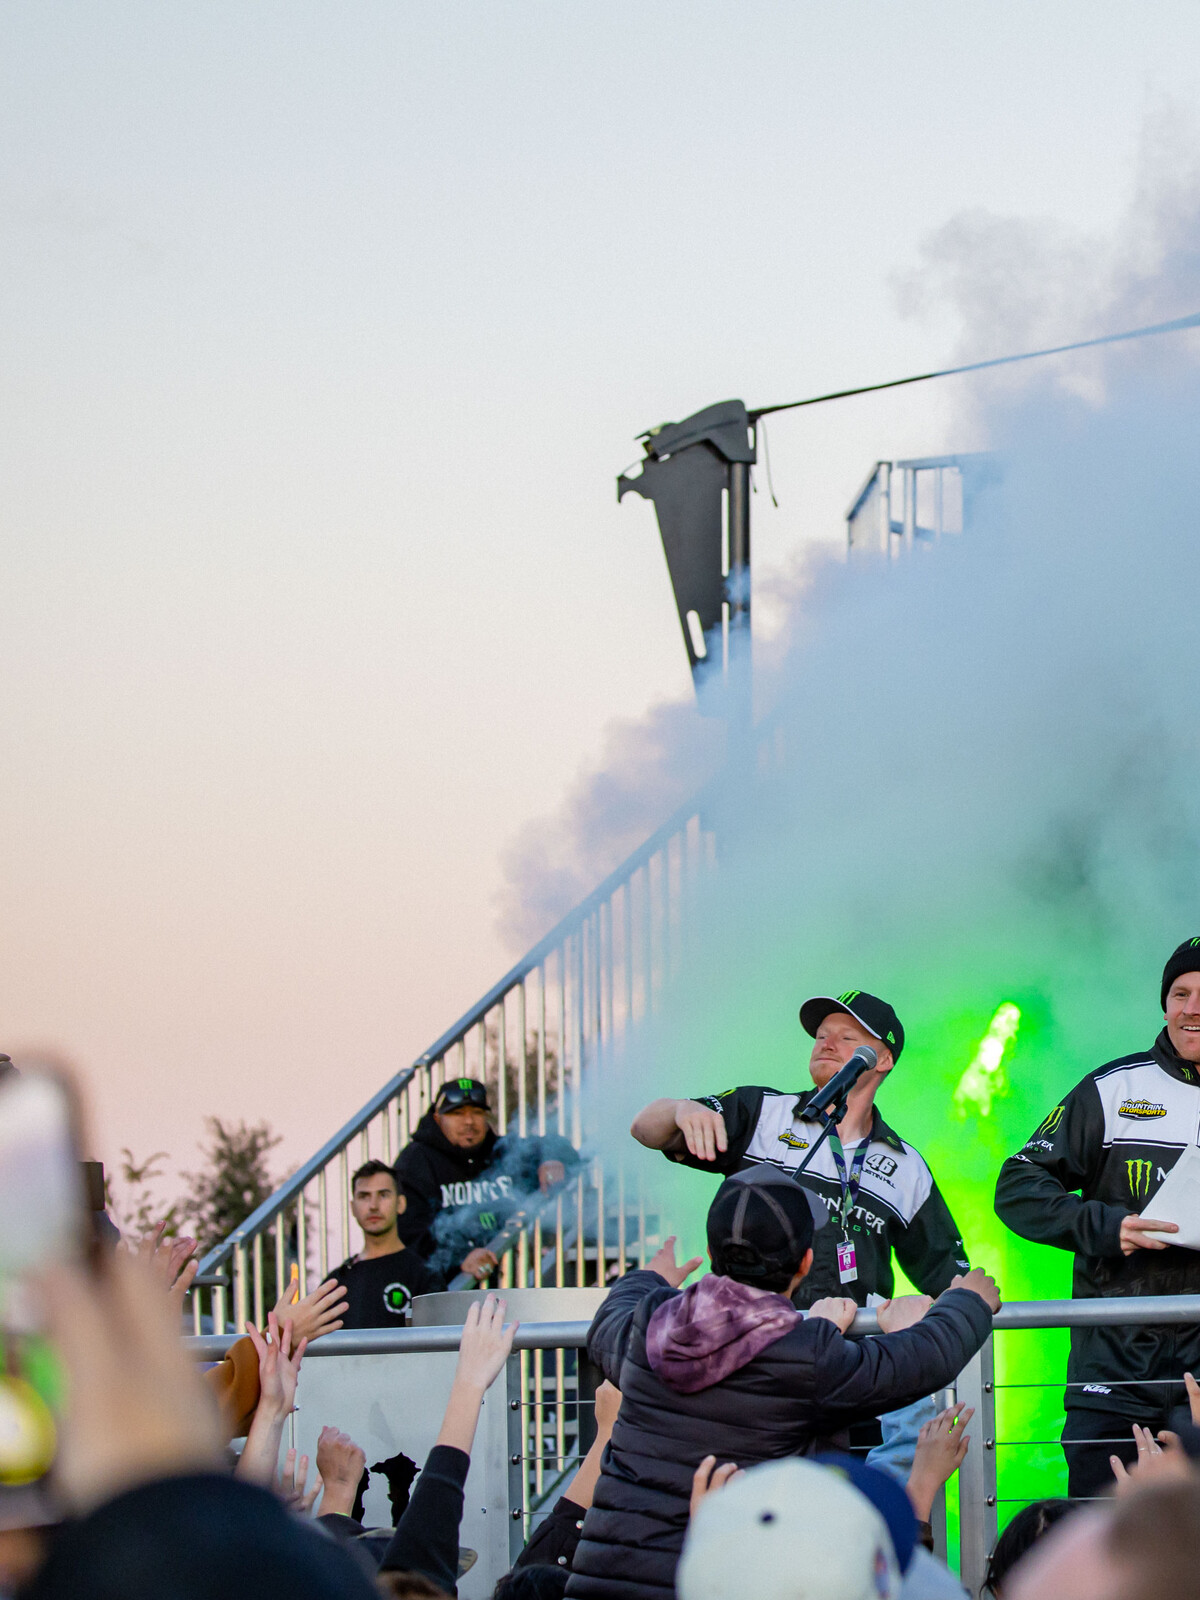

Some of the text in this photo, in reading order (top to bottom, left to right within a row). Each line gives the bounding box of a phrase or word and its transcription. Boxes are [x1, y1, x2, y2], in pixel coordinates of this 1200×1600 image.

[1121, 1100, 1163, 1111] MOUNTAIN
[865, 1153, 898, 1177] 46
[861, 1168, 883, 1181] USTIN
